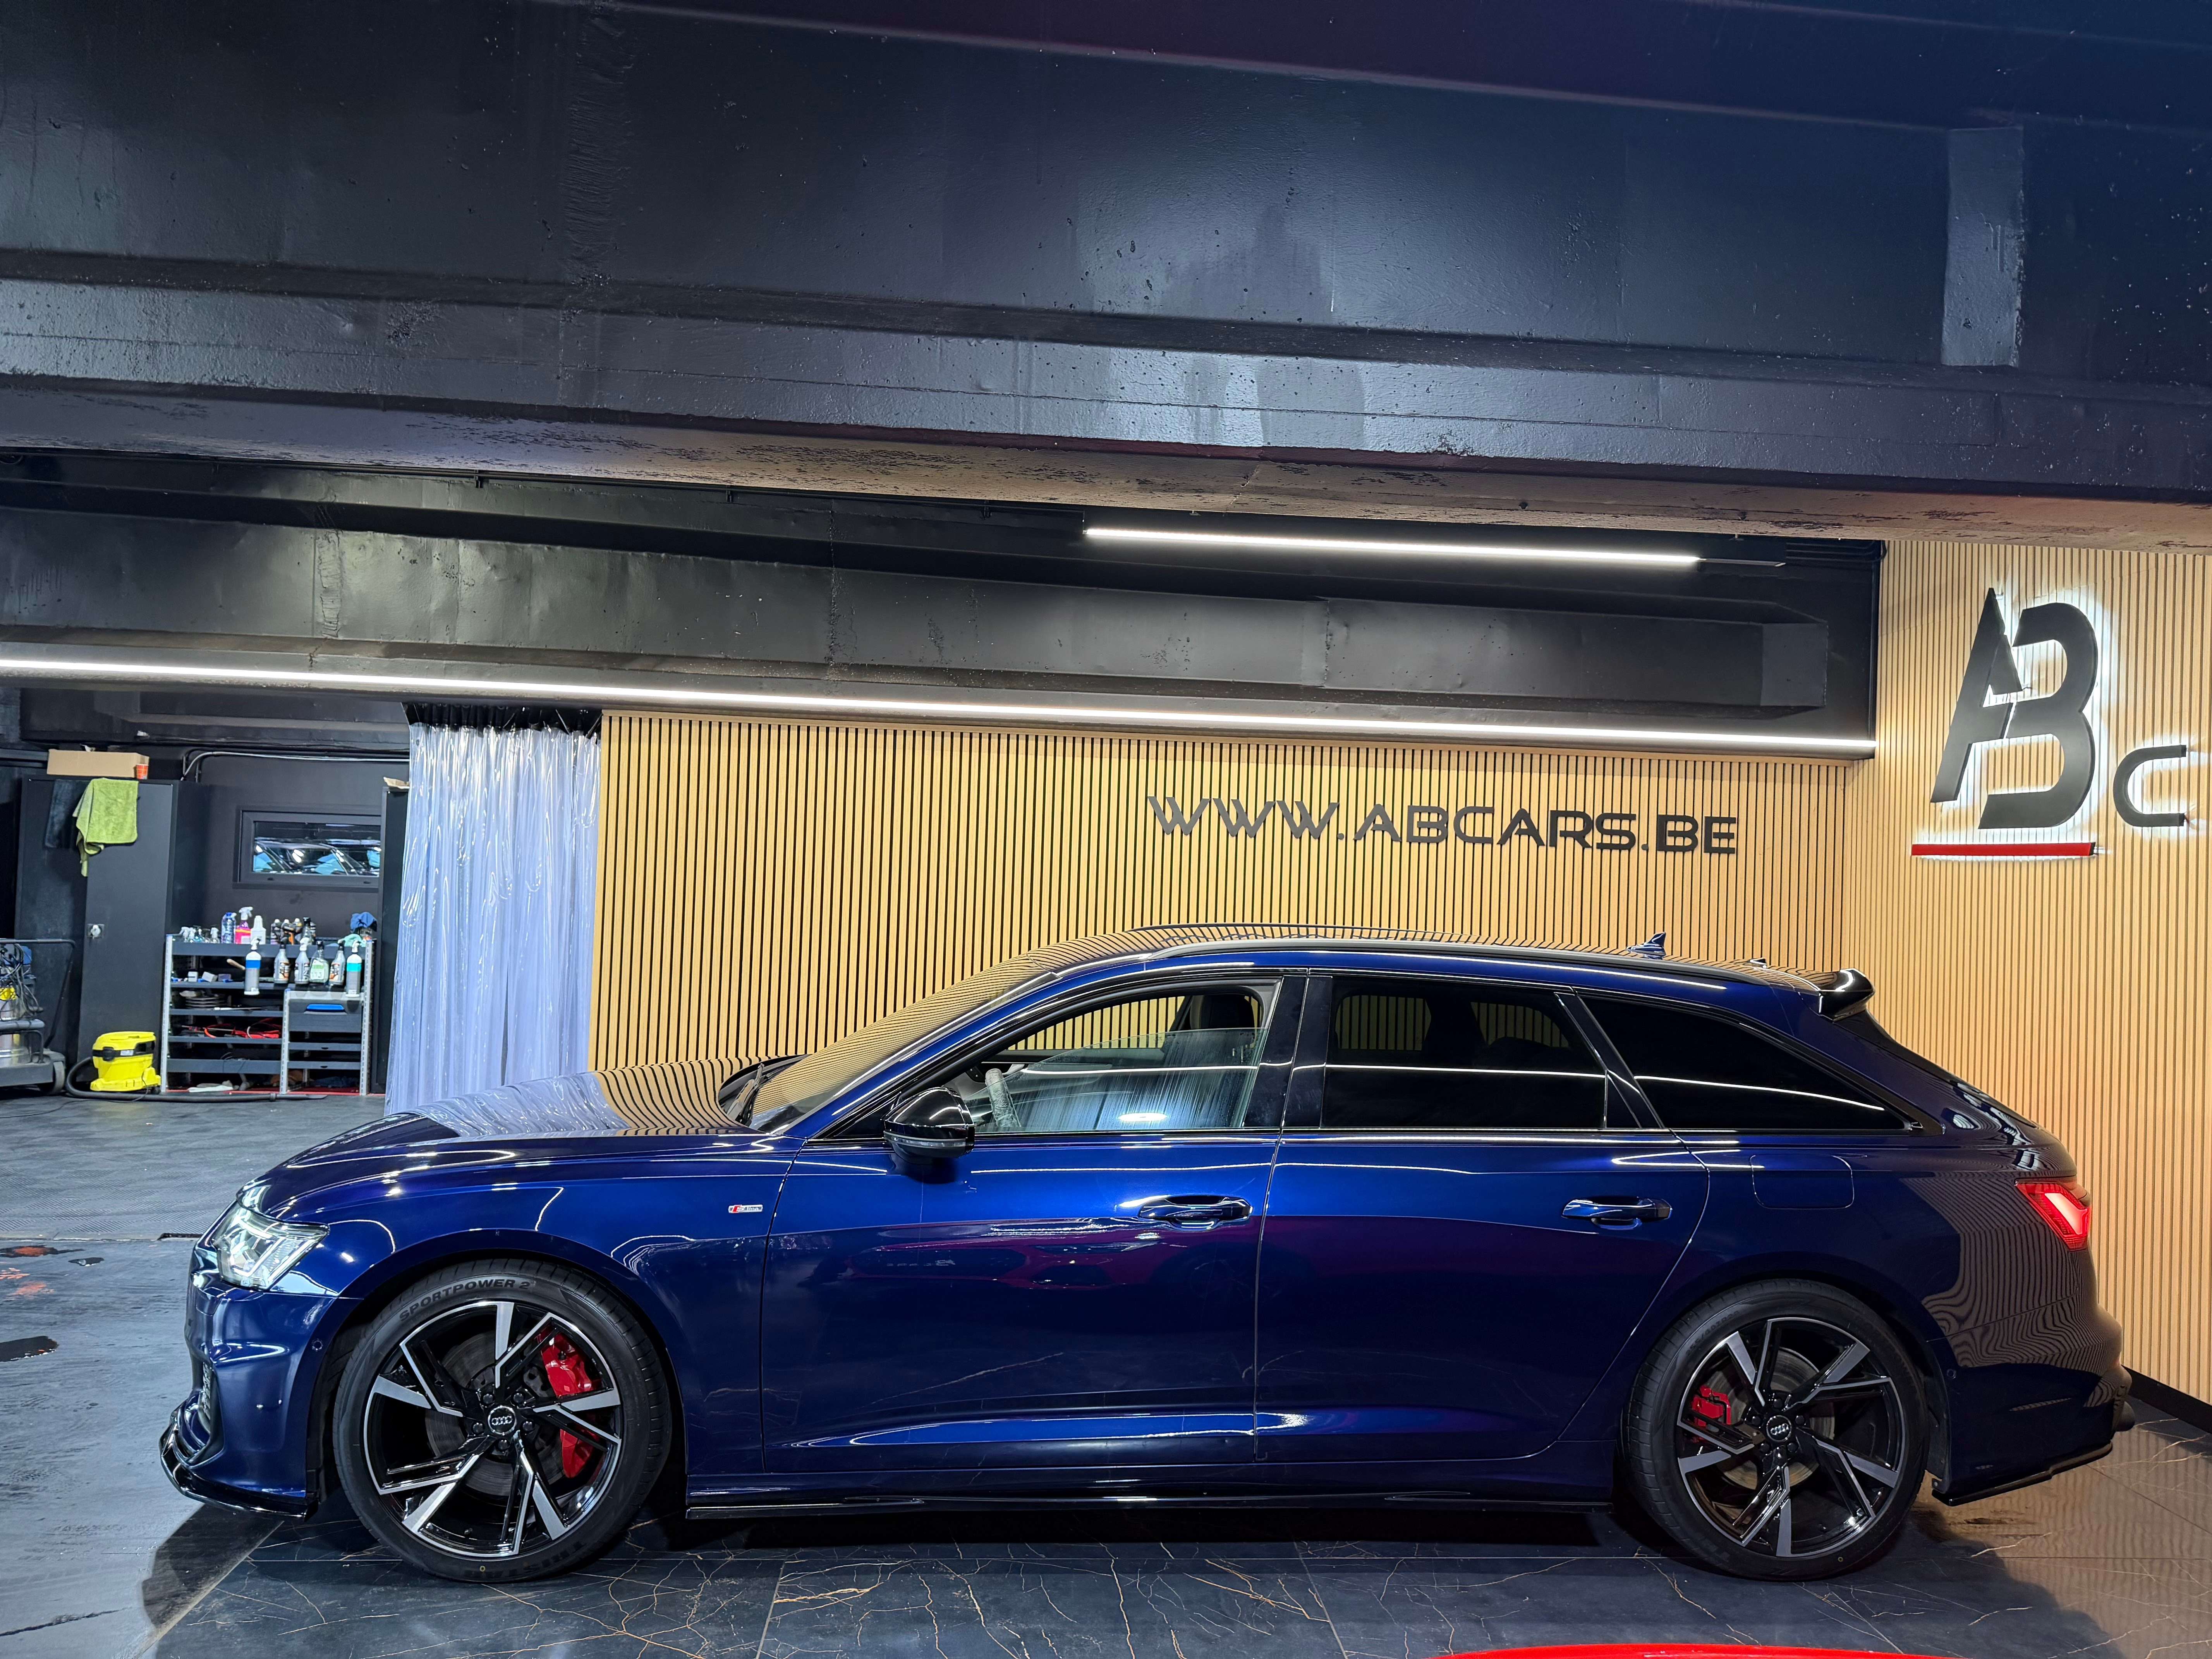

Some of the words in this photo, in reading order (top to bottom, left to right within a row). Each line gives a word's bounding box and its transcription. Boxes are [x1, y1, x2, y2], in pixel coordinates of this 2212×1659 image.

[1147, 796, 1736, 854] WWW.ABCARS.BE
[399, 1279, 515, 1320] SPORTPOWER
[519, 1281, 531, 1290] 2
